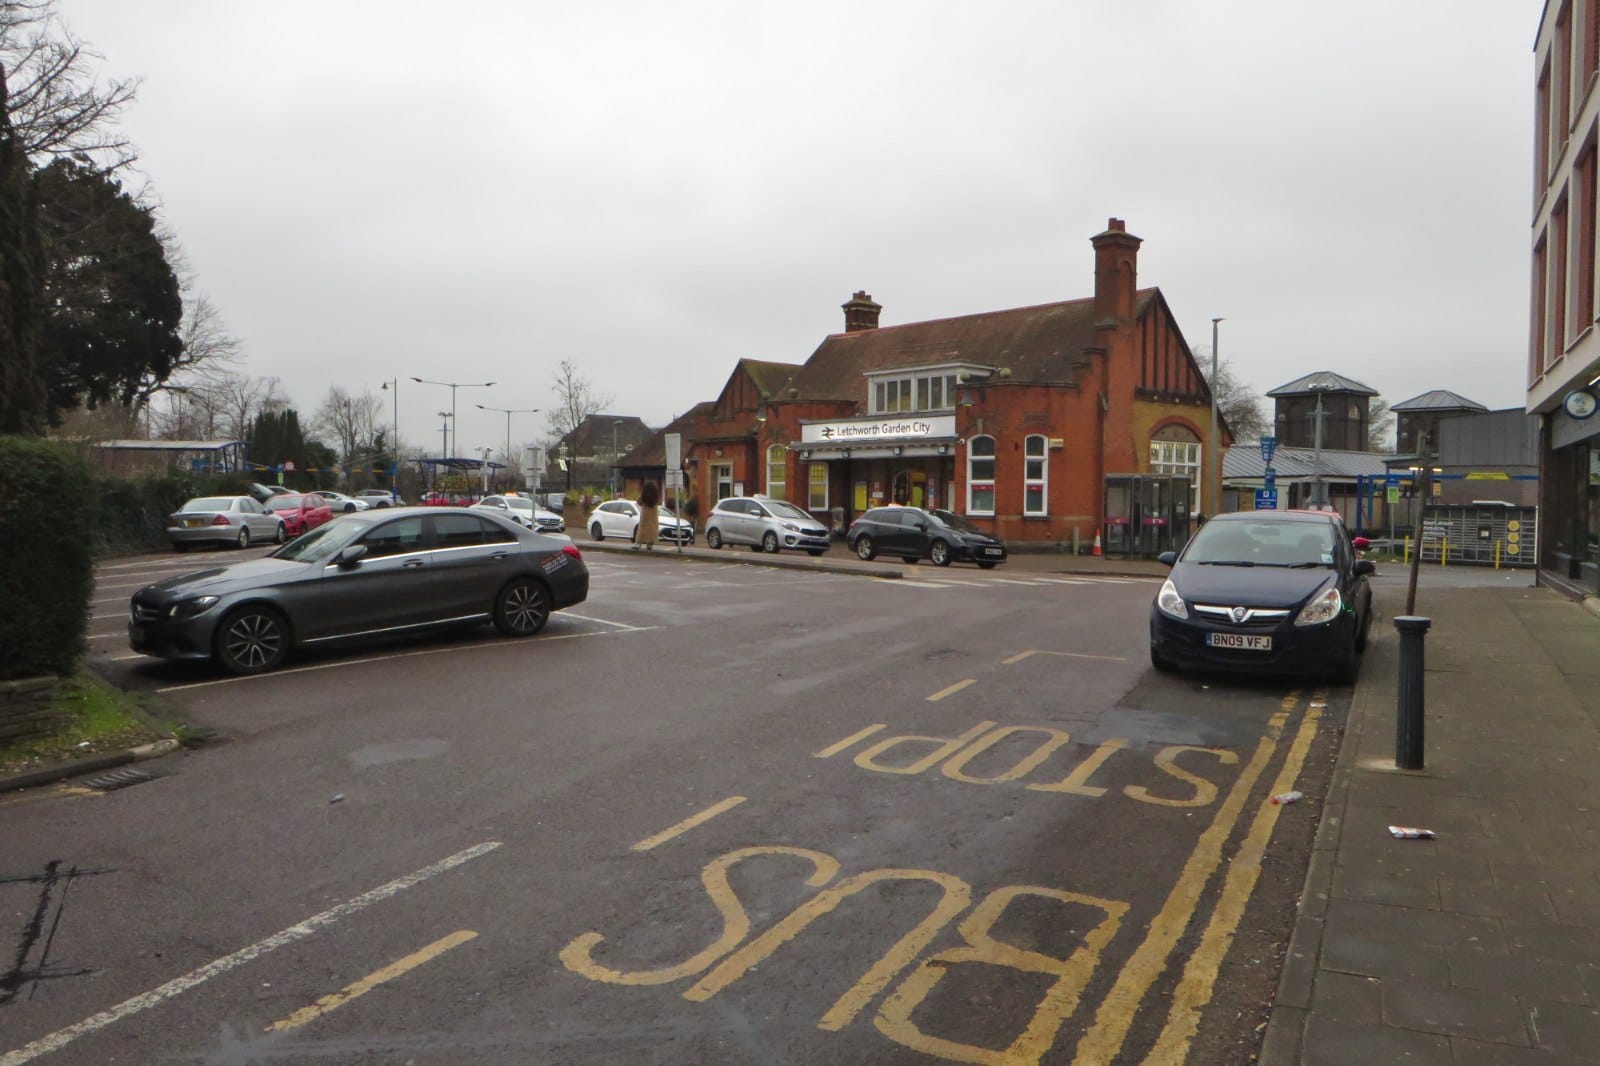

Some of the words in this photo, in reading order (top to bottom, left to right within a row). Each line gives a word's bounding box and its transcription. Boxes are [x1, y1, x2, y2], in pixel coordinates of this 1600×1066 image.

[837, 424, 880, 436] Letchworth
[881, 422, 911, 434] Garden
[913, 421, 931, 434] City
[1213, 633, 1243, 647] BN09
[1247, 635, 1270, 649] VFJ
[853, 720, 1239, 808] STOP
[558, 844, 1131, 1066] BUS
